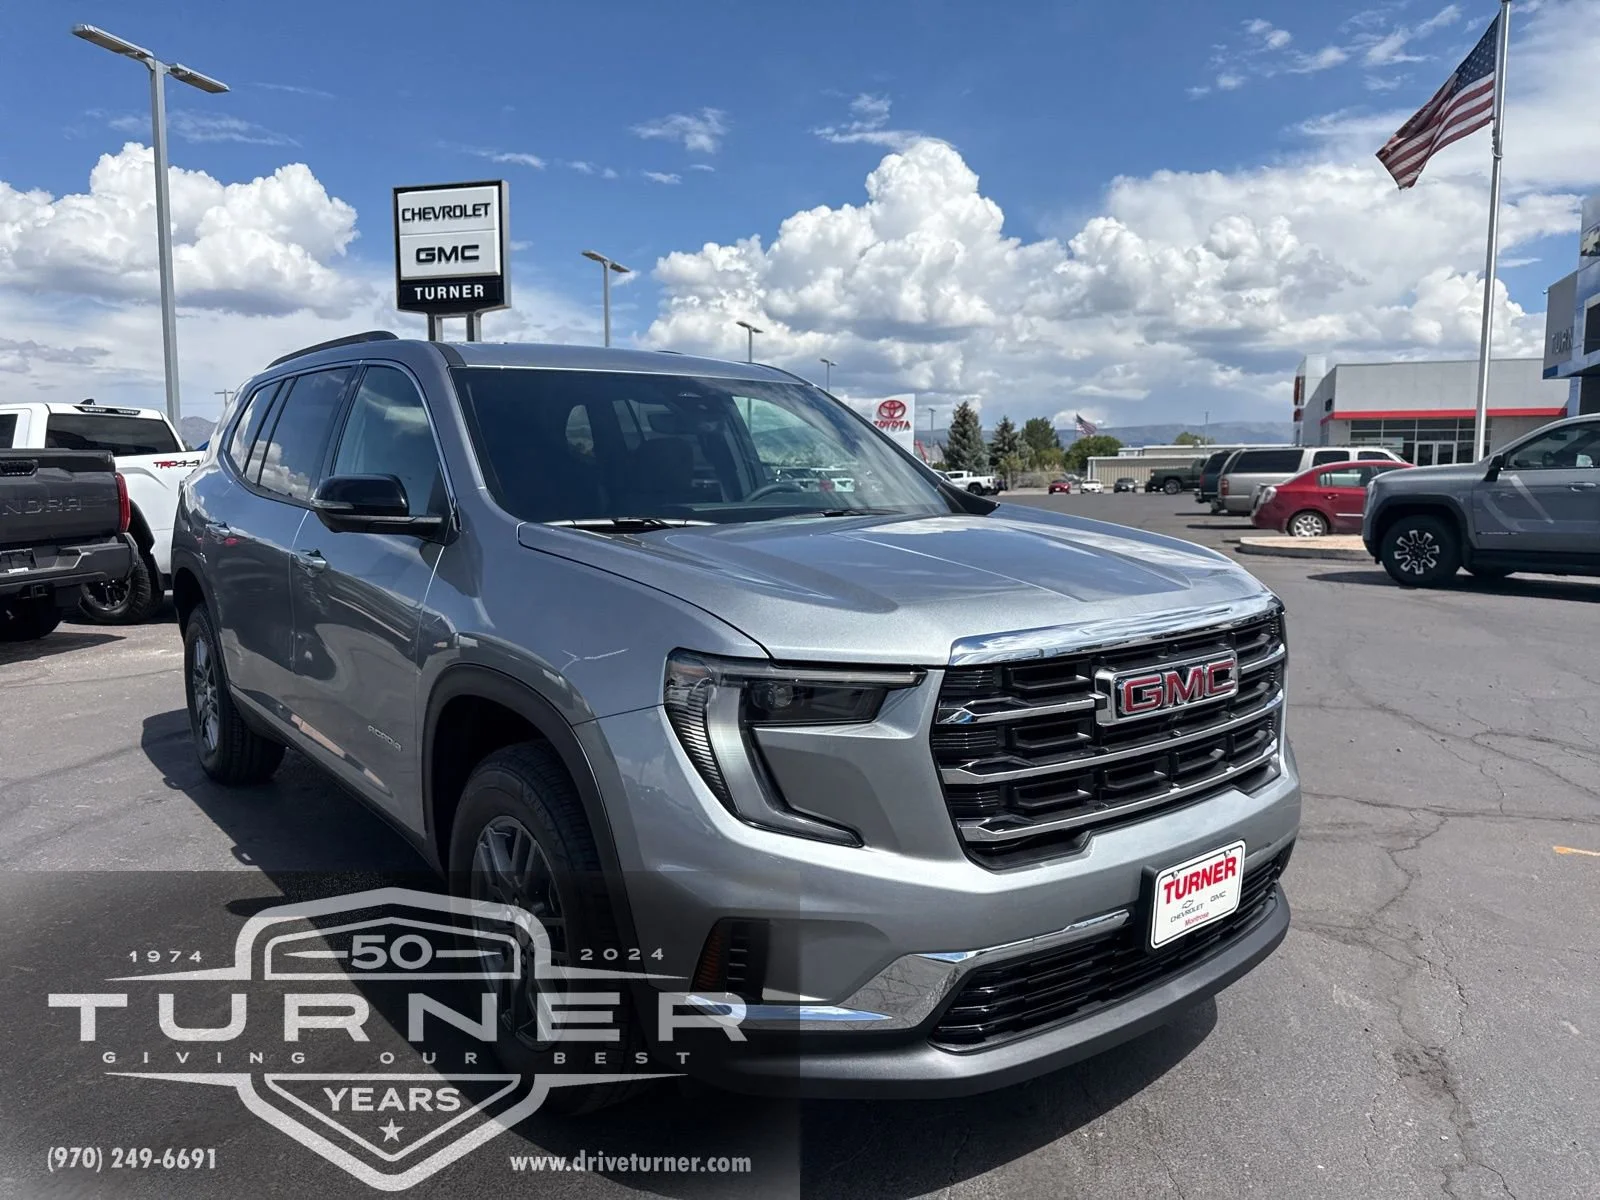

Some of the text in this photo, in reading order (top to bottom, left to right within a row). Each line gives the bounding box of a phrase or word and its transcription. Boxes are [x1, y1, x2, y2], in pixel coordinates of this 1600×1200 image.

[401, 202, 491, 222] CHEVROLET
[415, 244, 480, 263] GMC
[414, 284, 484, 300] TURNER
[1121, 658, 1237, 715] GMC
[1163, 856, 1237, 905] TURNER
[1210, 890, 1227, 902] GMC
[1170, 902, 1205, 923] CHEVROLET
[1184, 912, 1210, 927] Montrose
